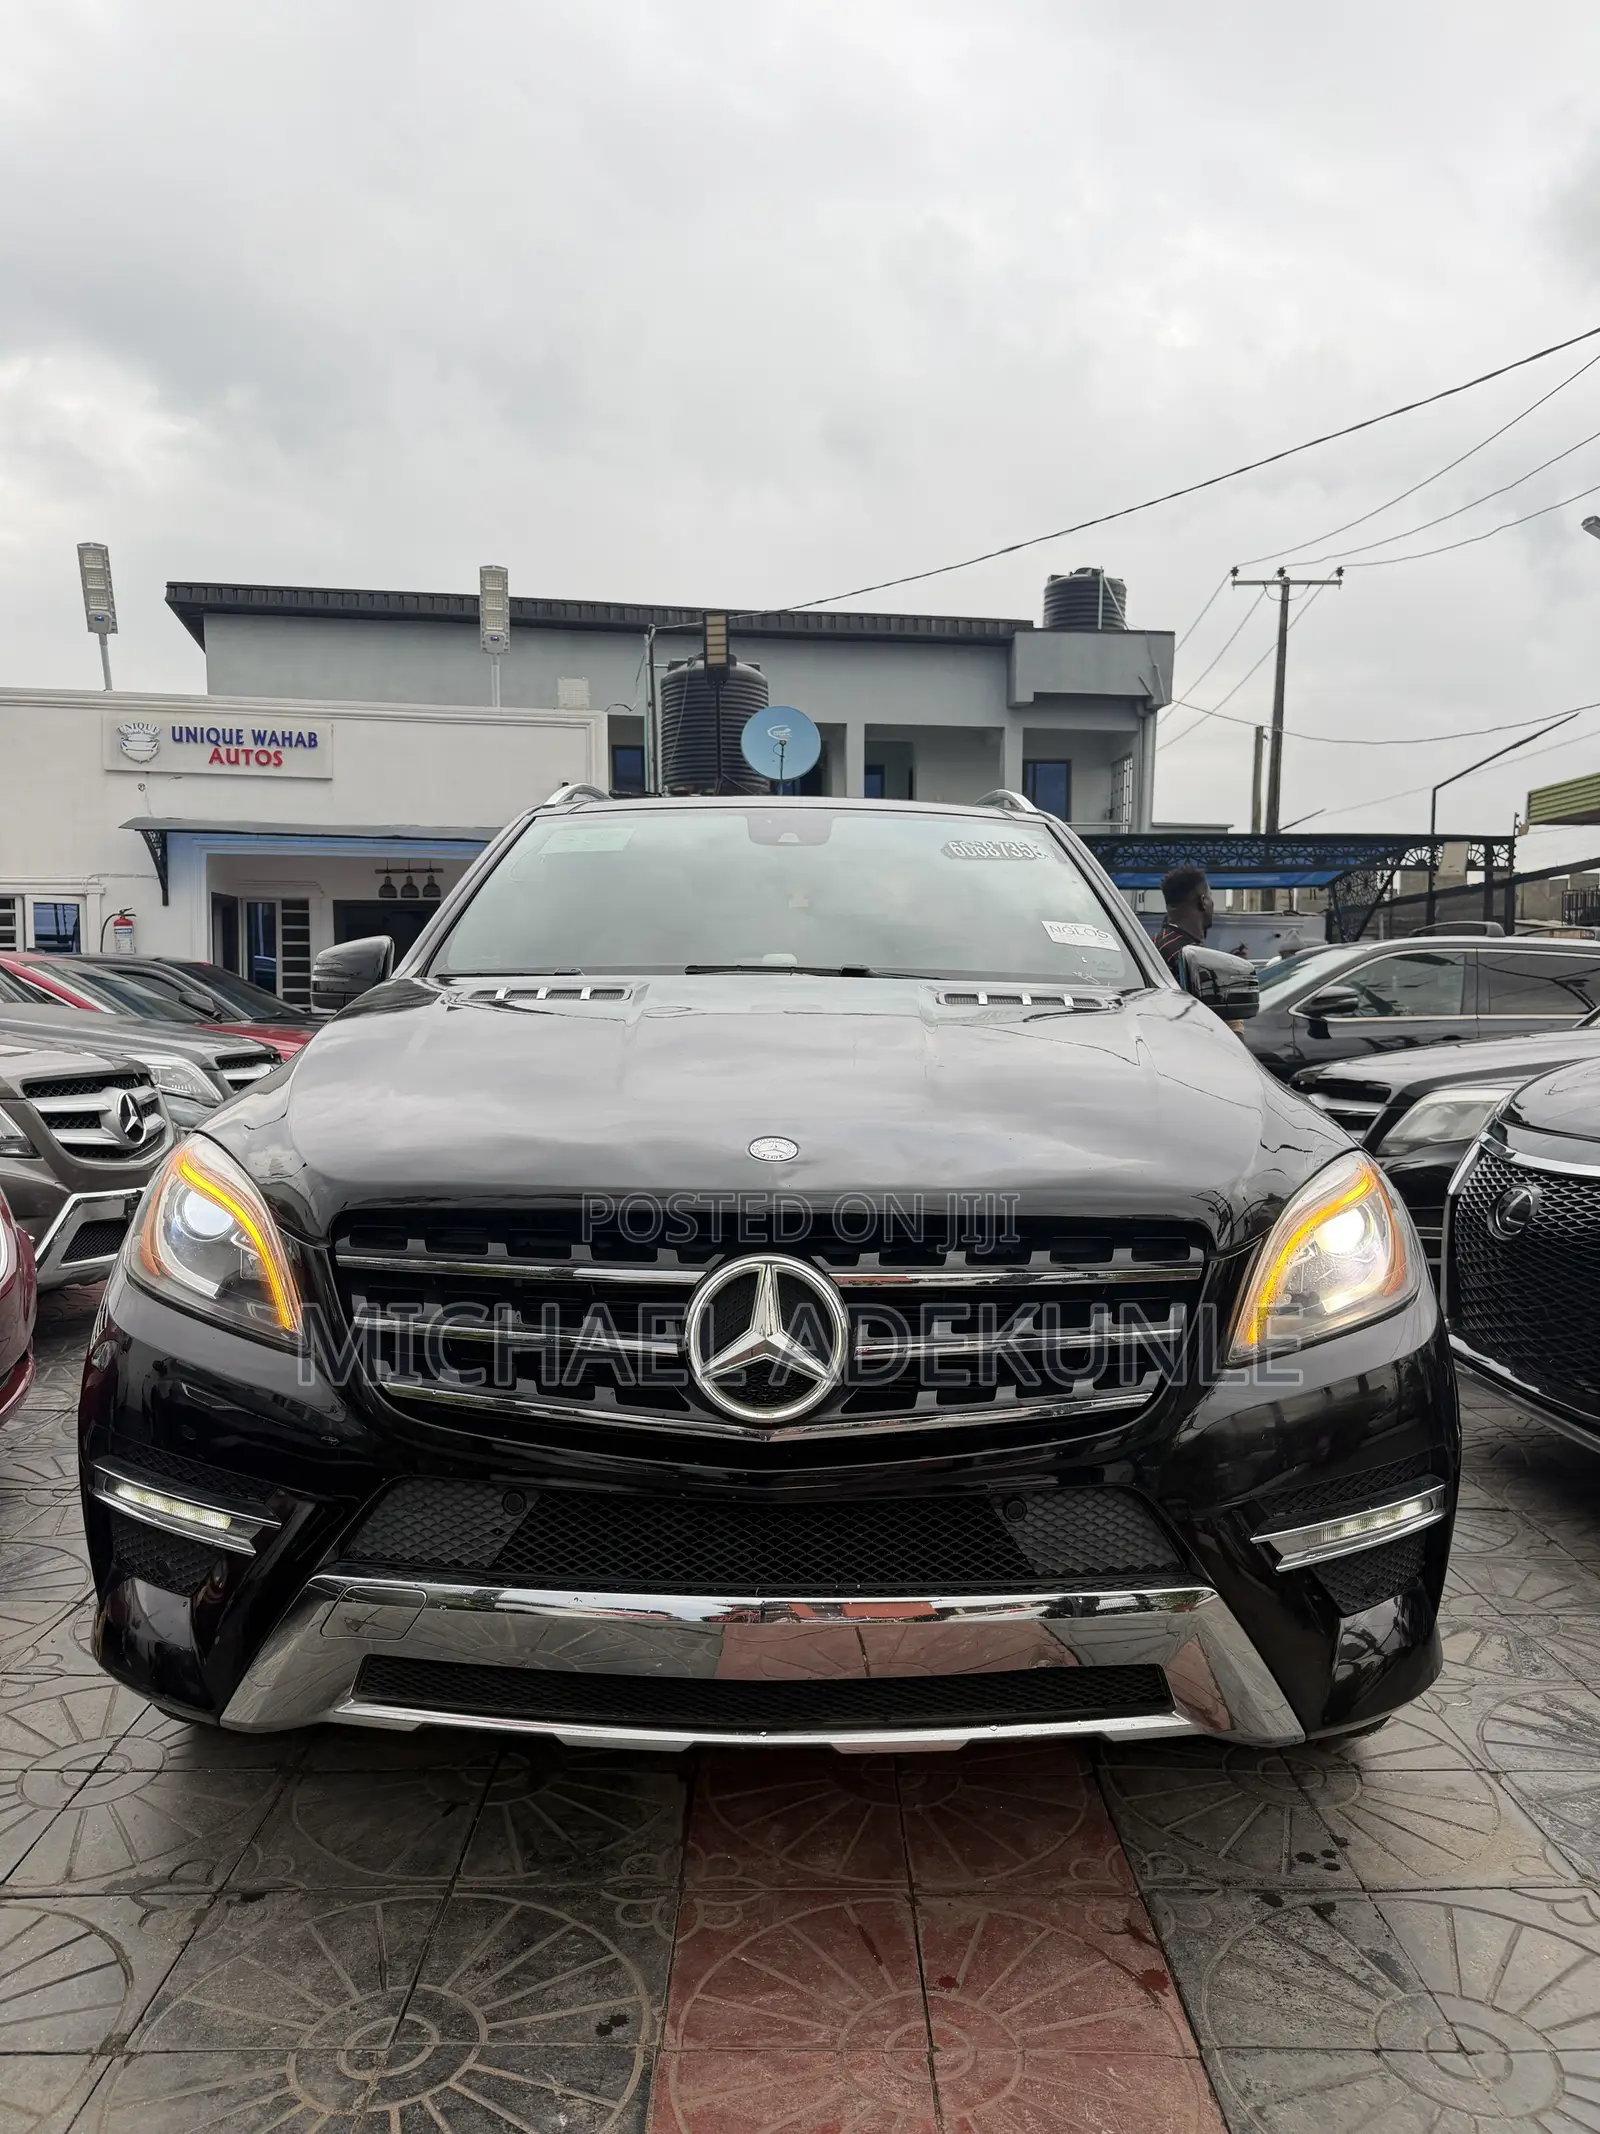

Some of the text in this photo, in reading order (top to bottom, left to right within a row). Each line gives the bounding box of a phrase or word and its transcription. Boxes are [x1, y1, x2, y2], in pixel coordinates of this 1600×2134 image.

[171, 726, 244, 747] UNIQUE
[251, 729, 318, 748] WAHAB
[208, 748, 283, 767] AUTOS
